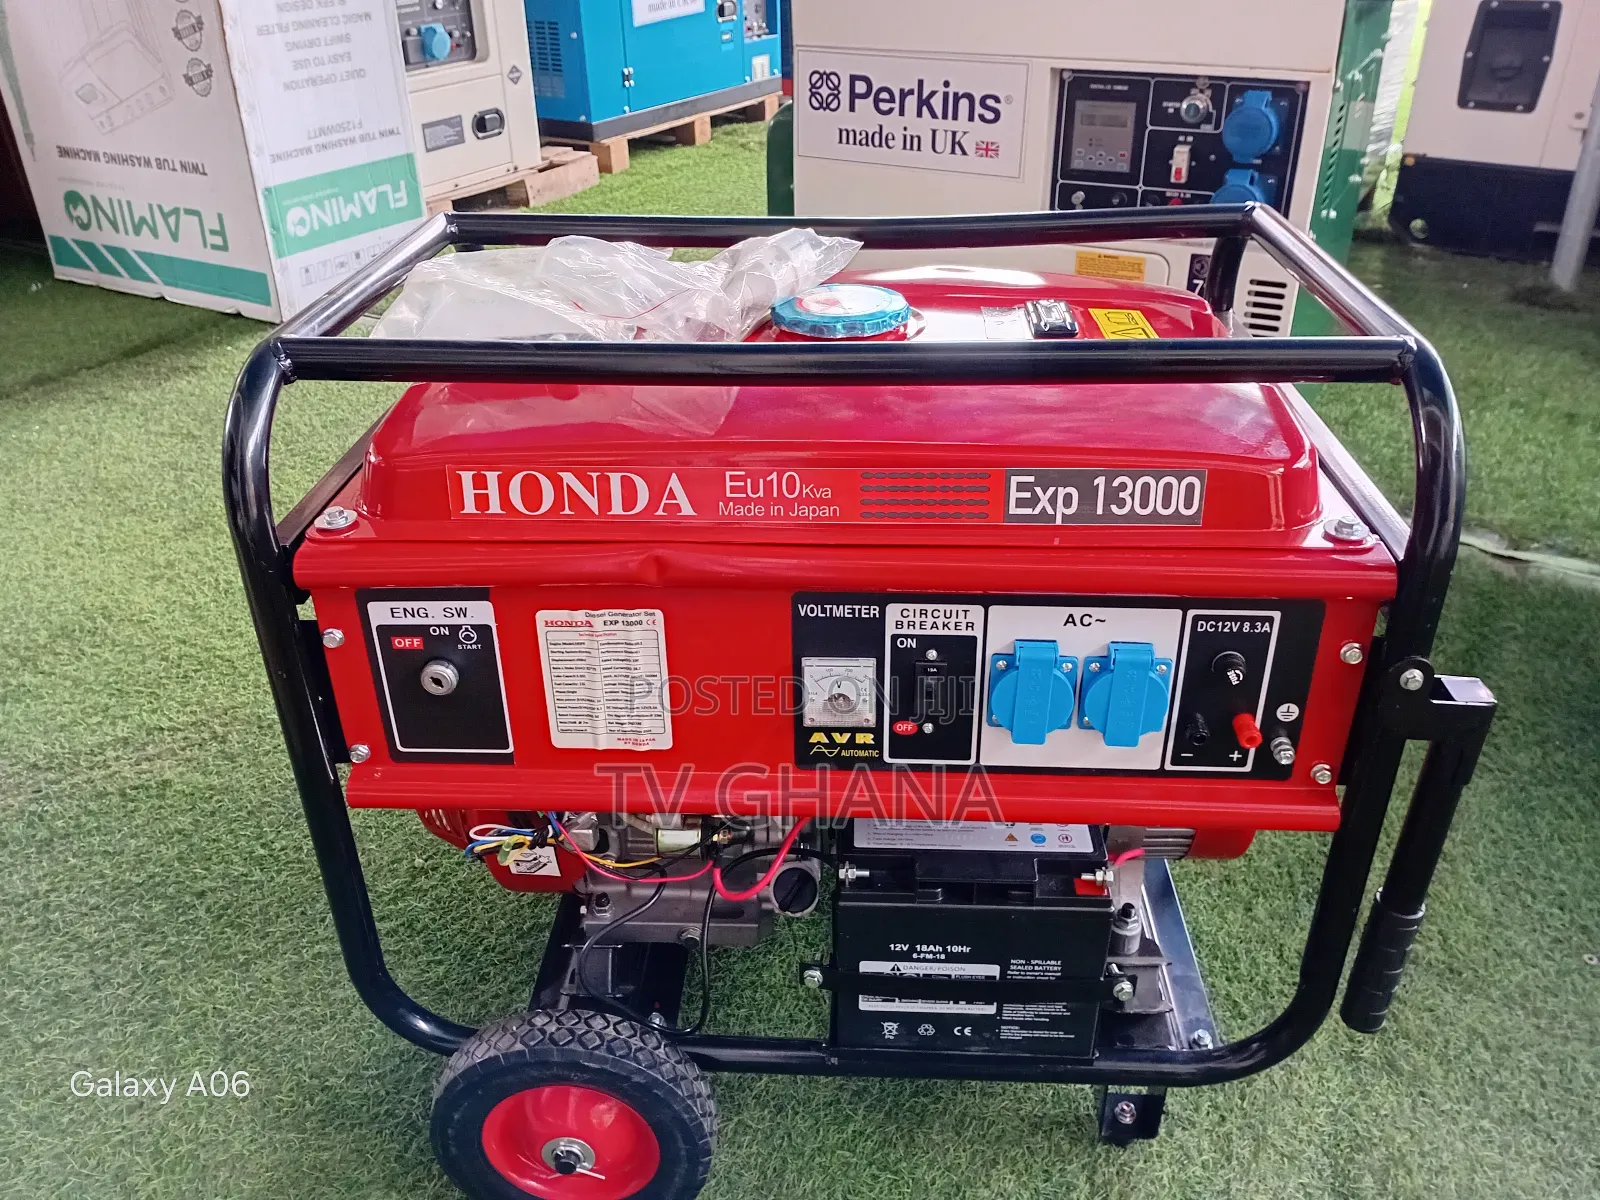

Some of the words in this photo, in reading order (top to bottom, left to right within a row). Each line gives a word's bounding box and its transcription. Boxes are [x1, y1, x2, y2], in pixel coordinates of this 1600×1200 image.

[292, 15, 340, 31] CLEANING
[342, 11, 372, 24] MAGIC
[257, 21, 290, 36] FILTER
[284, 36, 321, 51] DRYING
[323, 33, 352, 46] SWIFT
[292, 59, 310, 70] USE
[312, 55, 326, 67] TO
[328, 52, 352, 65] EASY
[339, 68, 367, 82] QUIET
[283, 72, 336, 92] OPERATION
[849, 73, 1002, 124] Perkins
[359, 131, 376, 142] TUB
[379, 126, 402, 138] TWIN
[314, 135, 358, 151] WASHING
[838, 124, 895, 149] made
[902, 126, 922, 152] in
[930, 128, 970, 156] UK
[56, 145, 97, 163] MACHINE
[103, 150, 151, 171] WASHING
[269, 147, 313, 164] MACHINE
[155, 157, 178, 172] TUB
[180, 159, 208, 176] TWIN
[456, 470, 698, 517] HONDA
[1008, 475, 1079, 524] Exp
[1093, 475, 1201, 516] 13000
[719, 501, 765, 517] Made
[770, 501, 784, 517] in
[788, 502, 840, 521] Japan
[390, 607, 435, 618] ENG.
[443, 607, 474, 618] SW.
[798, 604, 880, 618] VOLTMETER
[900, 608, 971, 620] CIRCUIT
[429, 626, 450, 635] ON
[544, 620, 594, 628] HONDA
[895, 620, 975, 631] BREAKER
[1197, 620, 1241, 633] DC12V
[1242, 621, 1271, 633] 8.3A
[394, 638, 421, 647] OFF
[897, 638, 917, 648] ON
[896, 723, 913, 732] OFF
[809, 732, 875, 744] AVR
[841, 749, 880, 757] AUTOMATIC
[889, 943, 909, 951] 12V
[915, 943, 943, 952] 18Ah
[946, 945, 971, 953] 10Hr
[903, 965, 966, 973] DANGER/POISON
